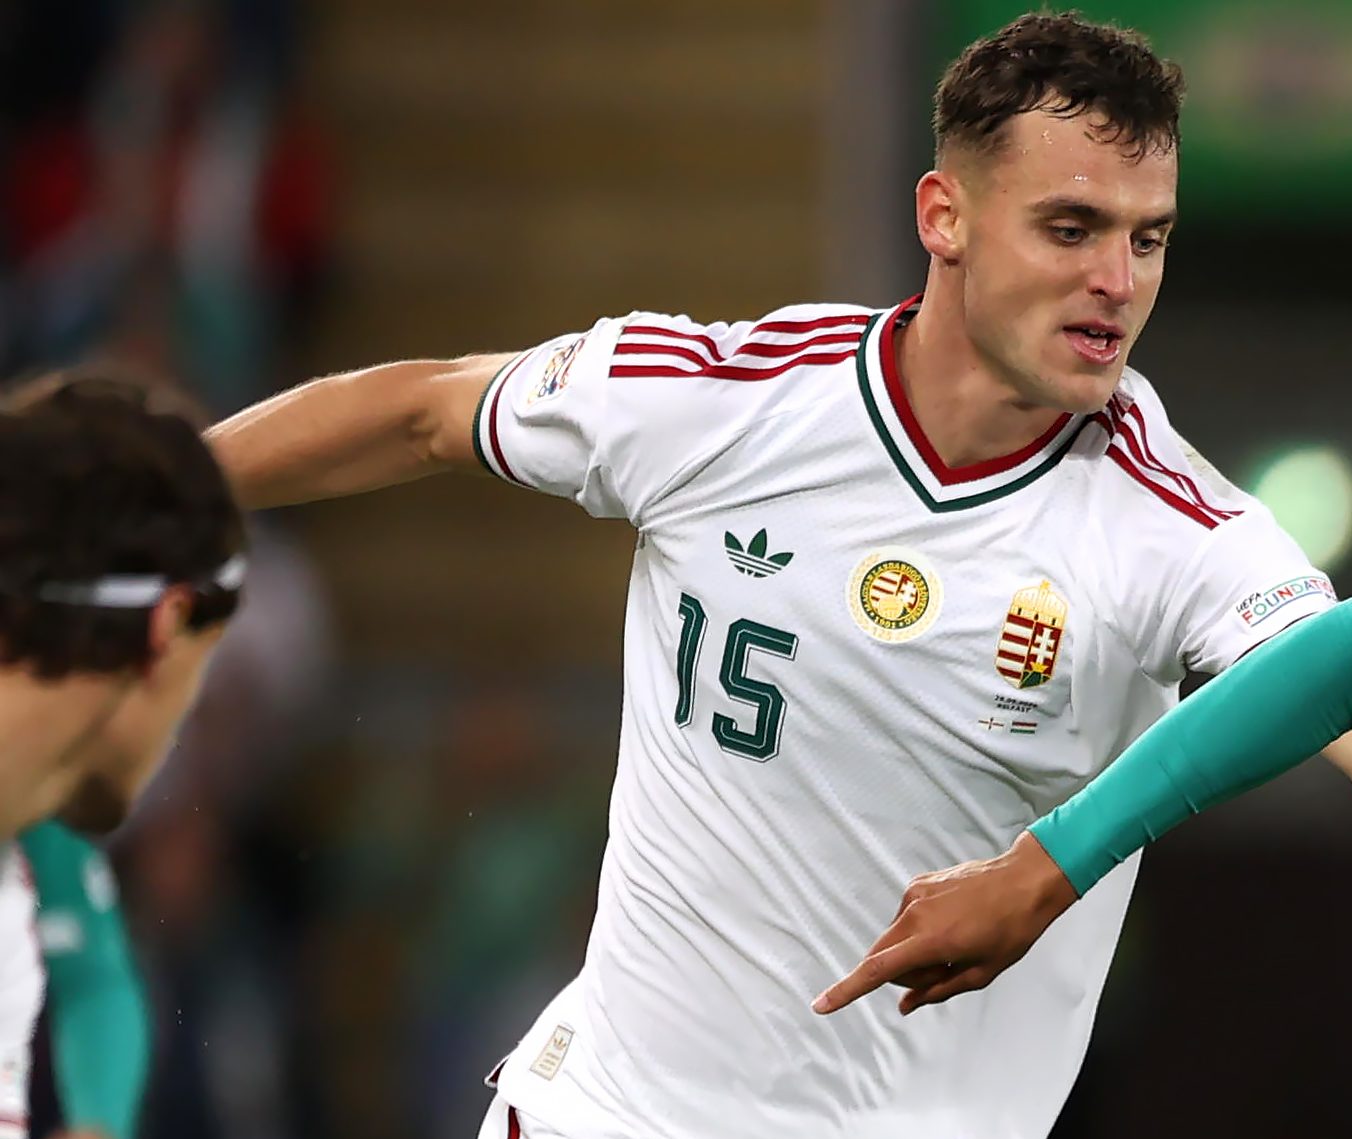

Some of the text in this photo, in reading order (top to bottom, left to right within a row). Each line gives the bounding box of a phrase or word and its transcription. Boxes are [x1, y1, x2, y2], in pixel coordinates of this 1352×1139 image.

[1236, 592, 1261, 613] UEFA
[1241, 579, 1335, 624] FOUNDAT
[675, 591, 799, 763] 15
[997, 702, 1032, 713] BELFAST
